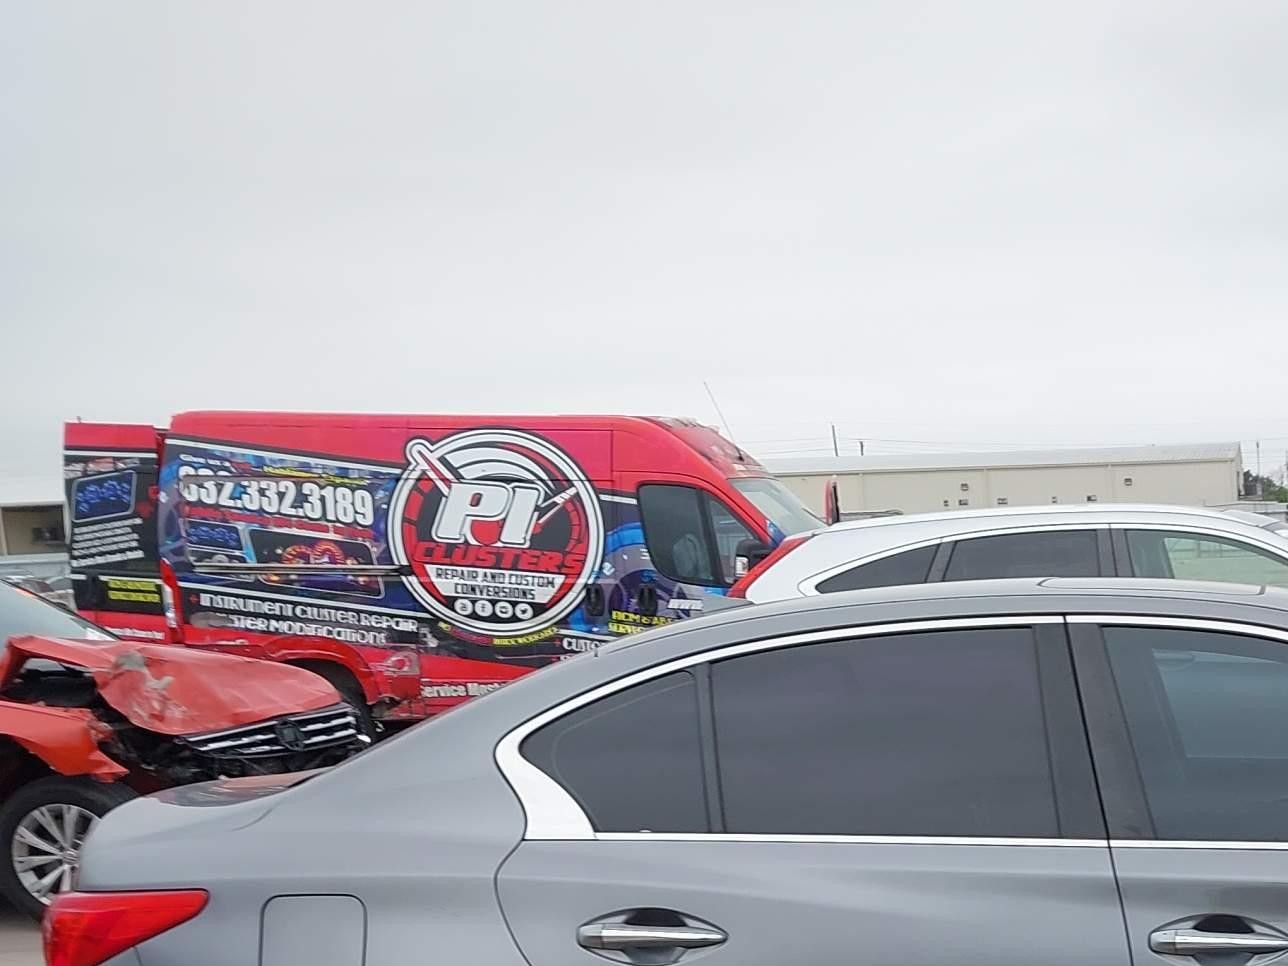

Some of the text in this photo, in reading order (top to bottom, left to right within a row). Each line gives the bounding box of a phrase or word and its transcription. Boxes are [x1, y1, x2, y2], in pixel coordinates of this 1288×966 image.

[432, 480, 544, 548] PI
[414, 541, 586, 574] CLUSTERS
[436, 567, 555, 588] REPAIR AND CUSTOM
[454, 583, 536, 600] CONVERSIONS
[294, 605, 359, 624] CLUSTER
